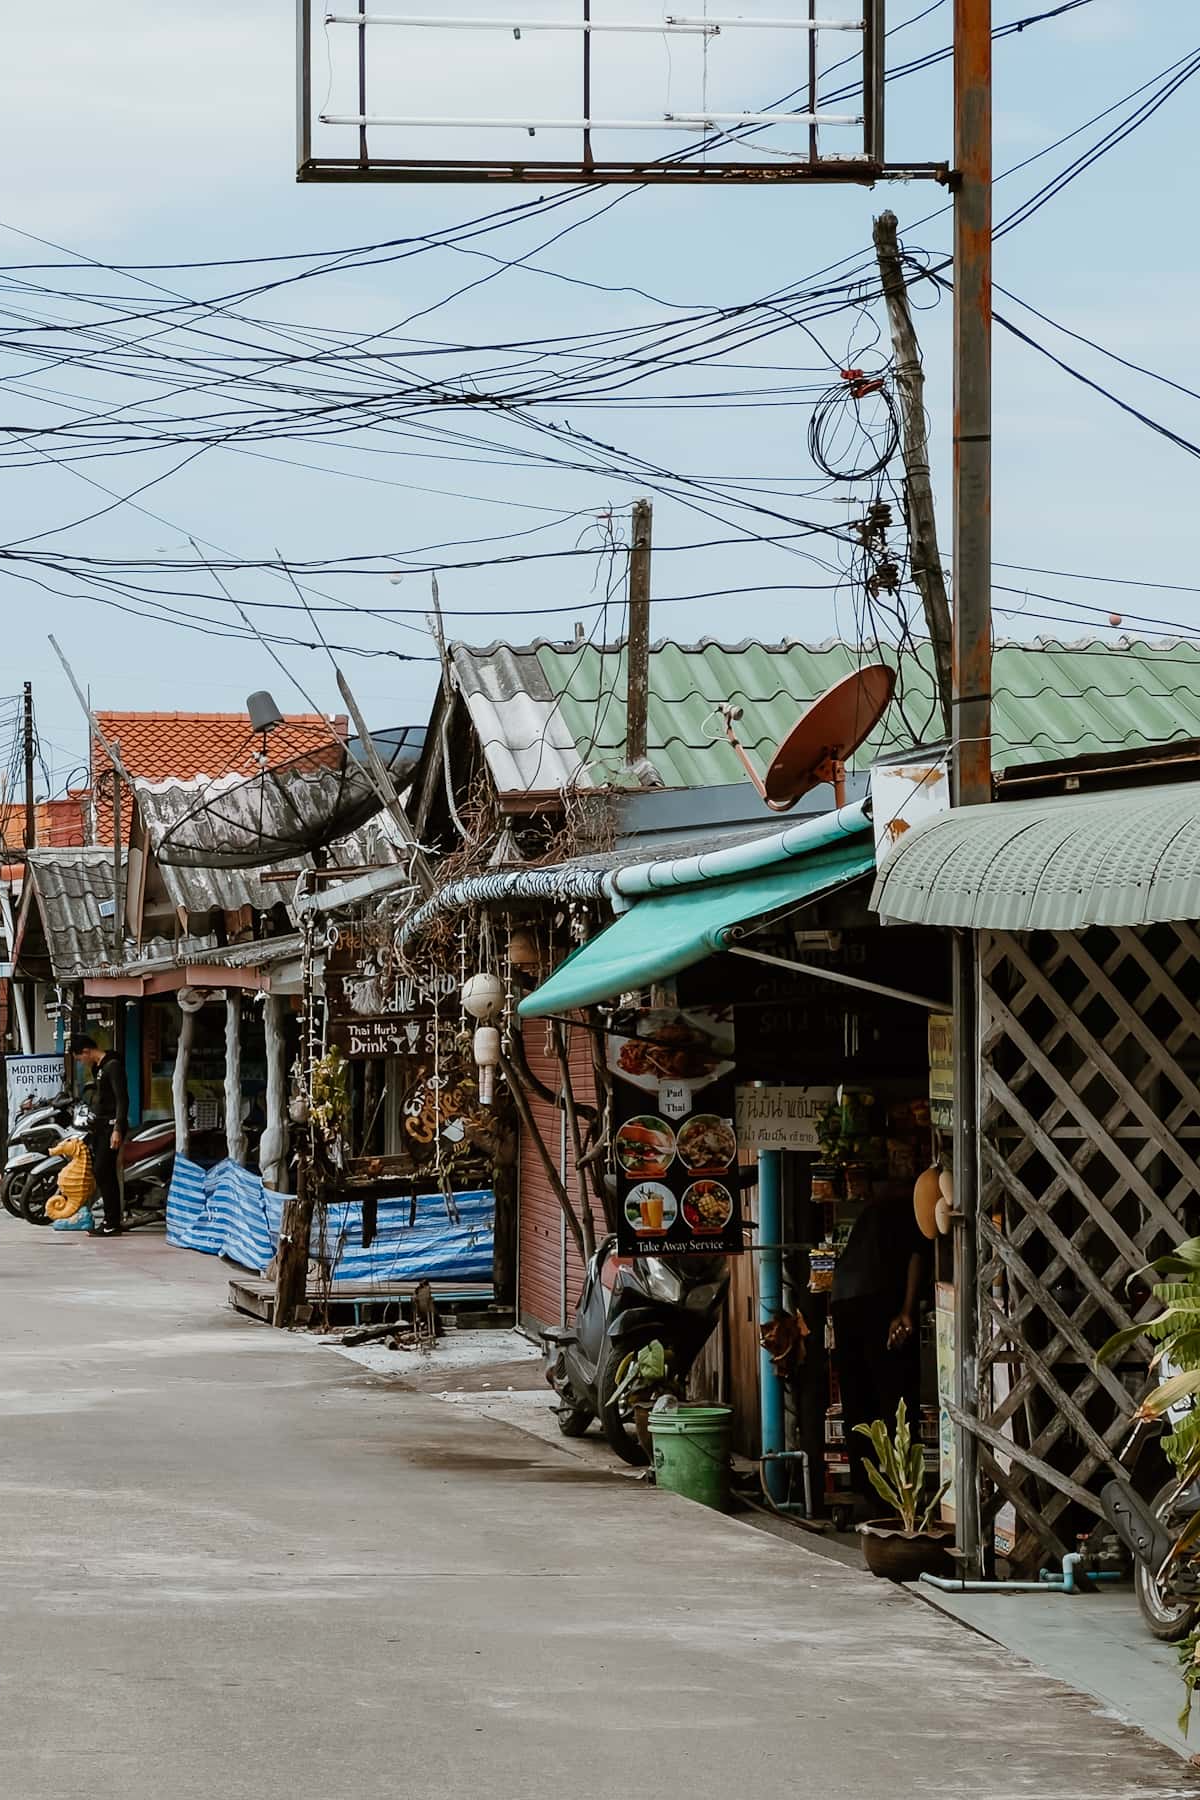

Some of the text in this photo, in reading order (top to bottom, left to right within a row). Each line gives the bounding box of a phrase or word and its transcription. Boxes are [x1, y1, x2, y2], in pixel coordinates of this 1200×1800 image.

[346, 1022, 398, 1036] Thai Hurb
[348, 1036, 389, 1055] Drink
[16, 1074, 61, 1085] FOR RENT
[666, 1088, 684, 1098] Pad
[665, 1103, 686, 1113] Thai
[637, 1239, 725, 1253] Take Away Service
